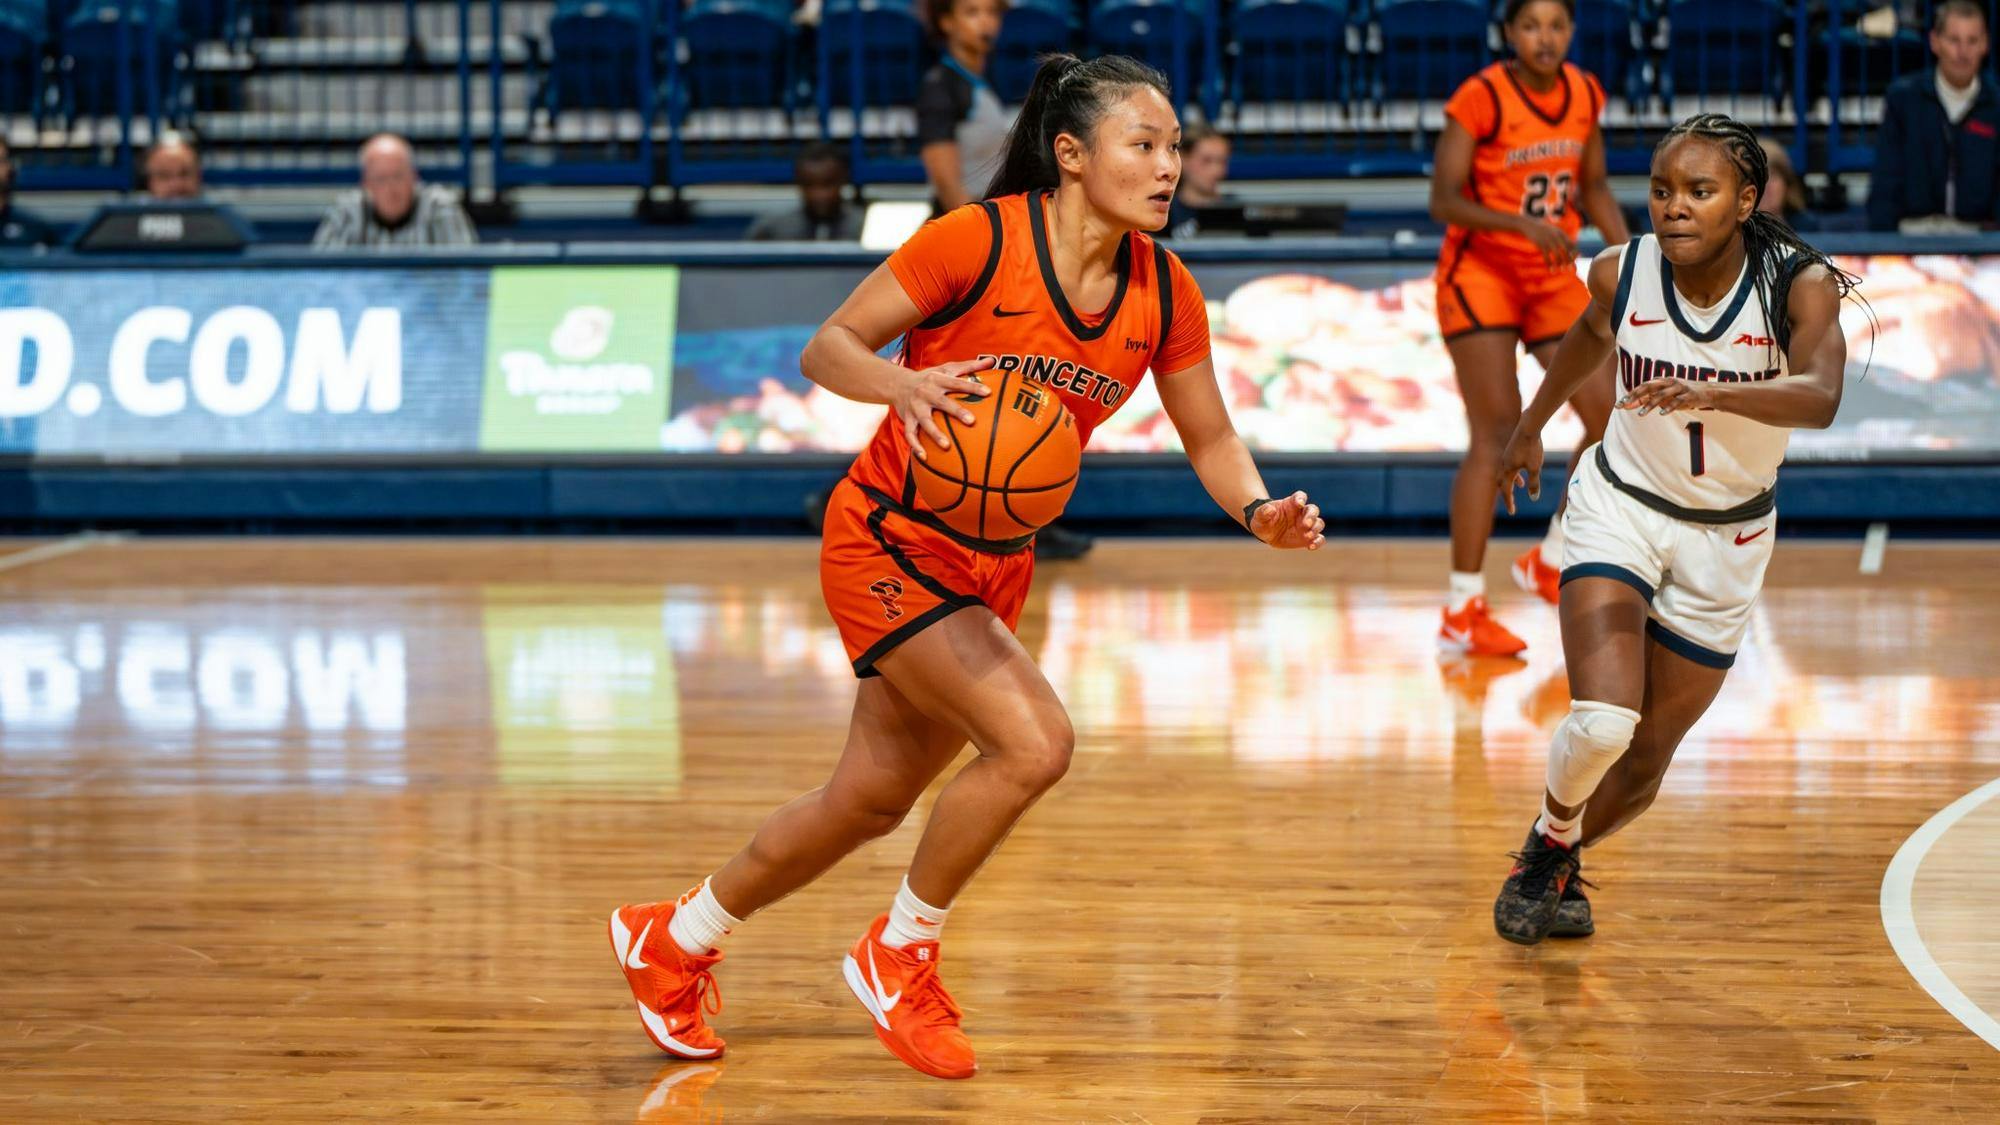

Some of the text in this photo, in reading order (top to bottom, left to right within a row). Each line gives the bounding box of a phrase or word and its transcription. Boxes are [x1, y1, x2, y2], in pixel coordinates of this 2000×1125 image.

[1521, 171, 1573, 221] 23
[0, 305, 402, 416] D.COM
[1125, 337, 1142, 353] Ivy
[976, 354, 1129, 409] RINCETO
[1684, 421, 1705, 477] 1
[869, 576, 904, 622] P
